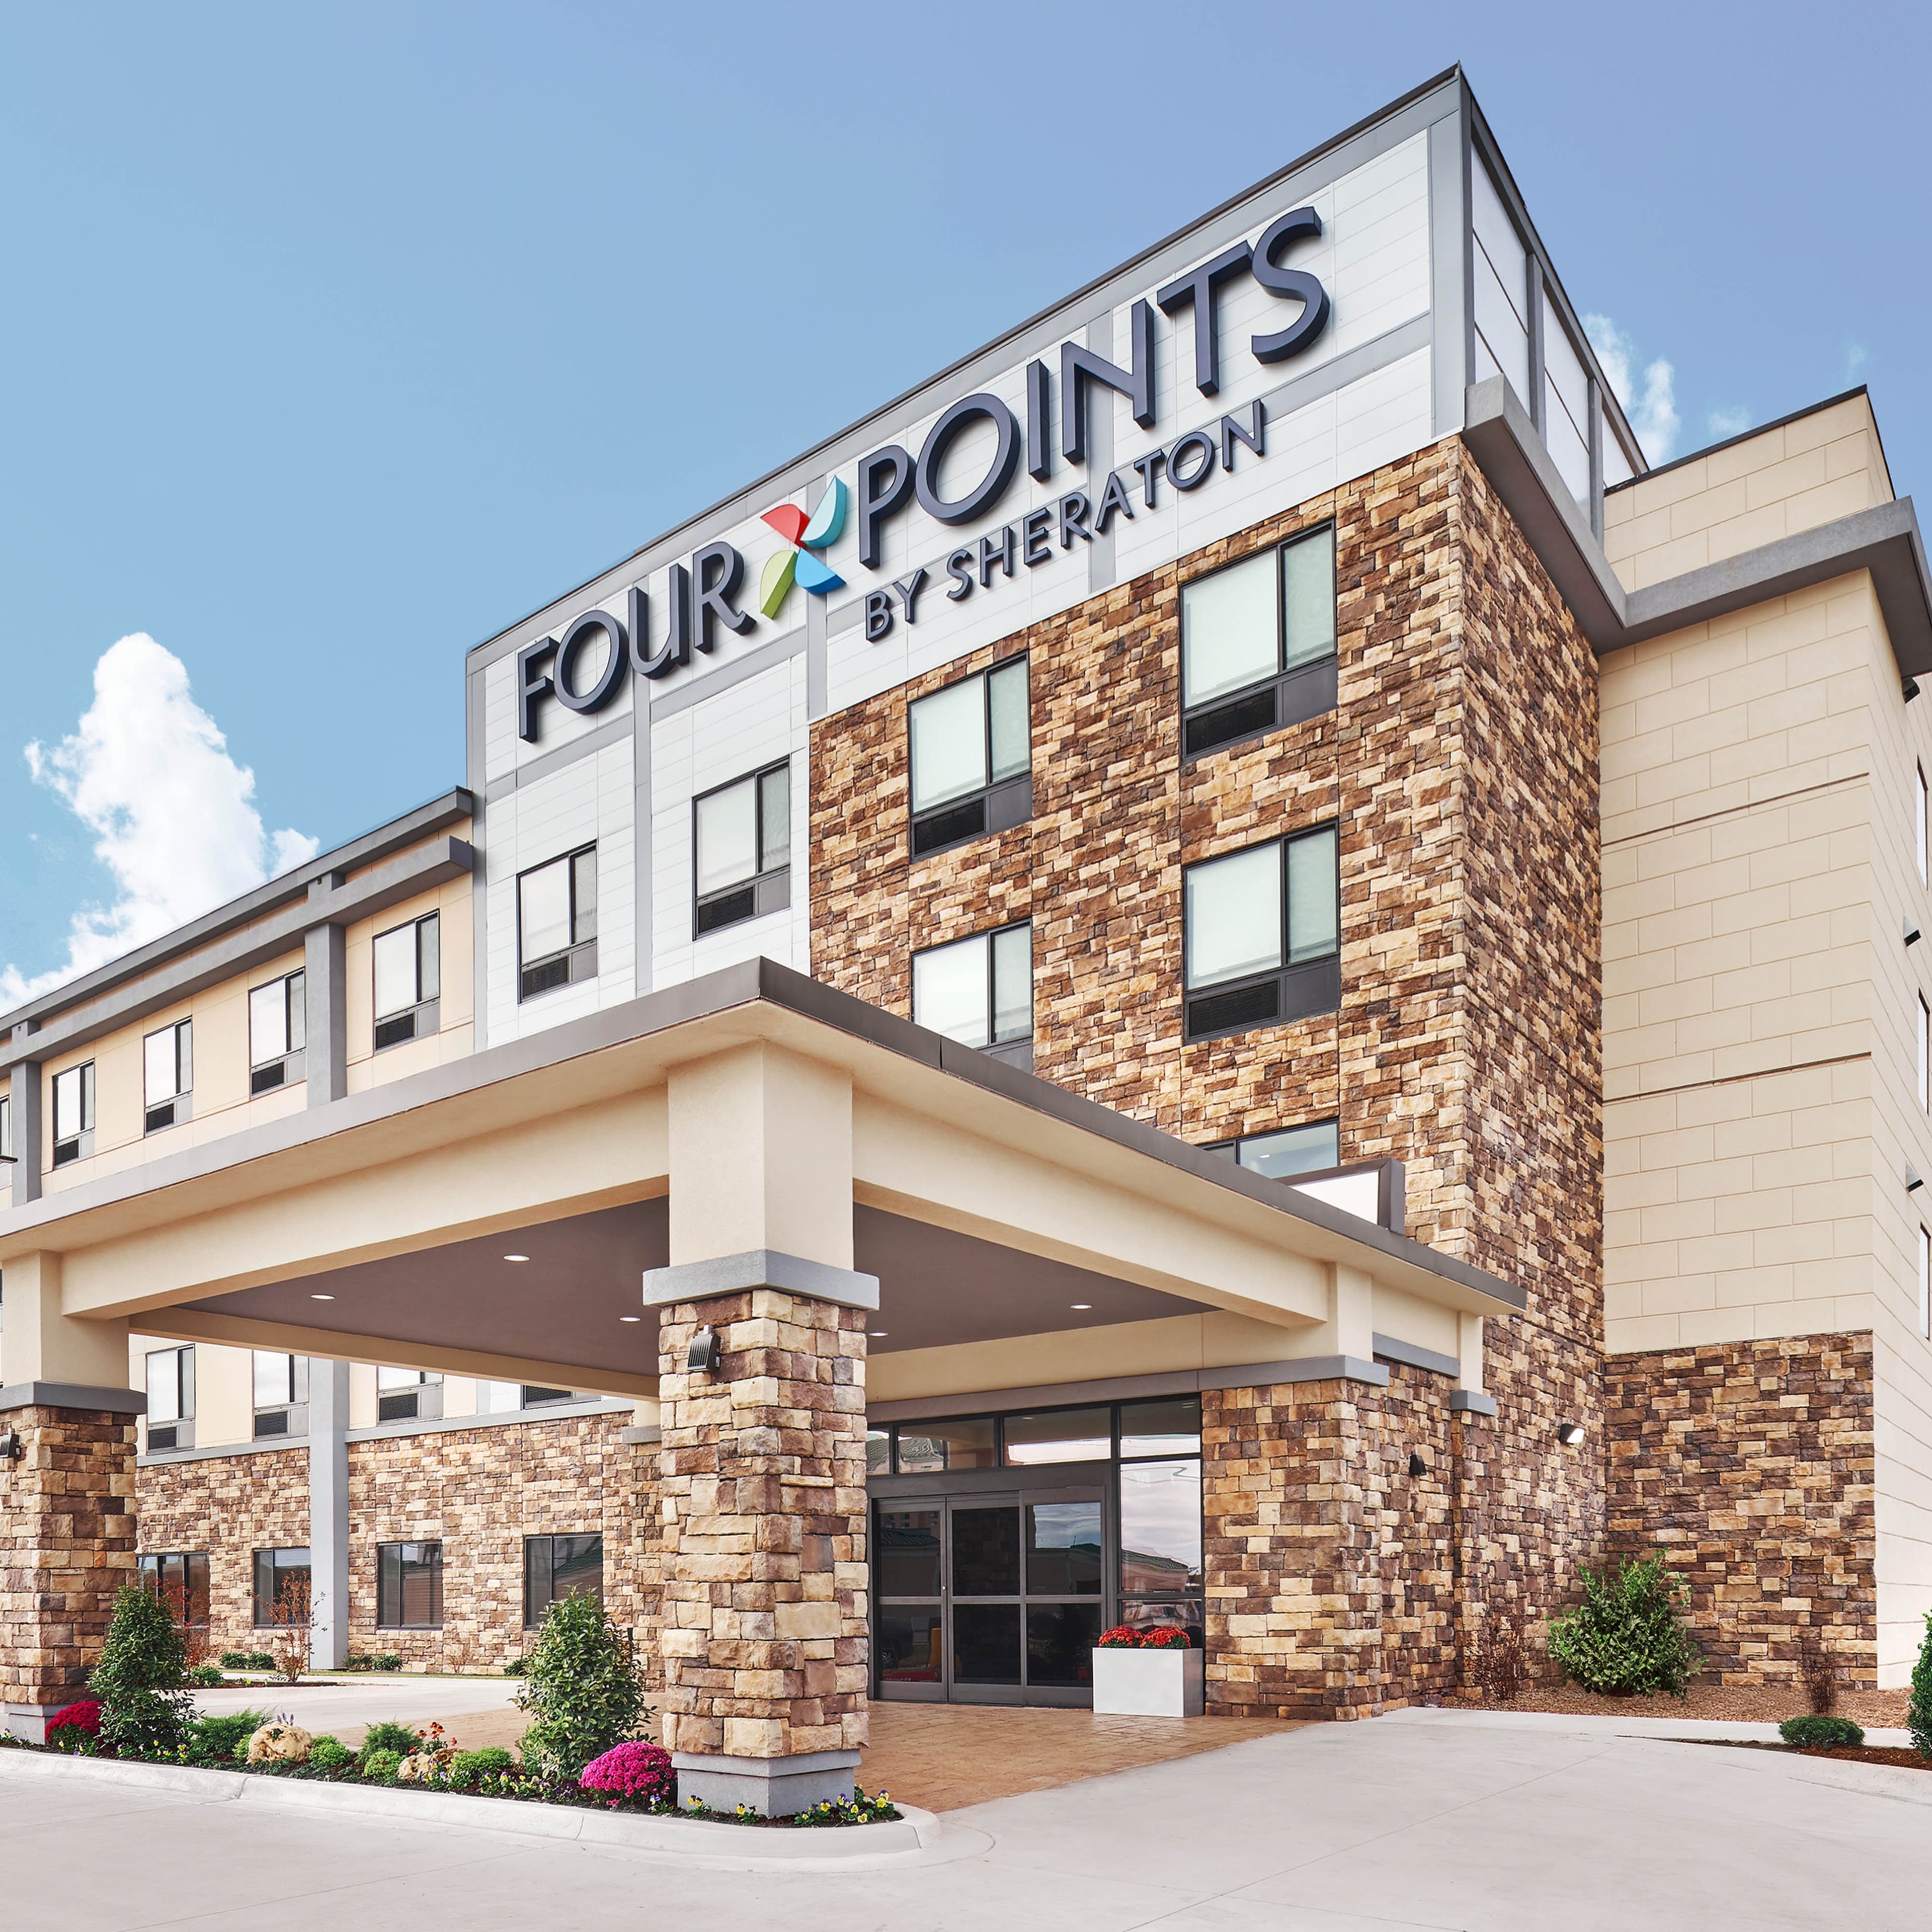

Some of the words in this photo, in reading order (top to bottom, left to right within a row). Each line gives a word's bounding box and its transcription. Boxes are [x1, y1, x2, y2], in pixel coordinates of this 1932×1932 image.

[517, 541, 756, 743] FOUR
[858, 206, 1330, 569] POINTS
[865, 569, 928, 642] BY
[946, 399, 1265, 601] SHERATON
